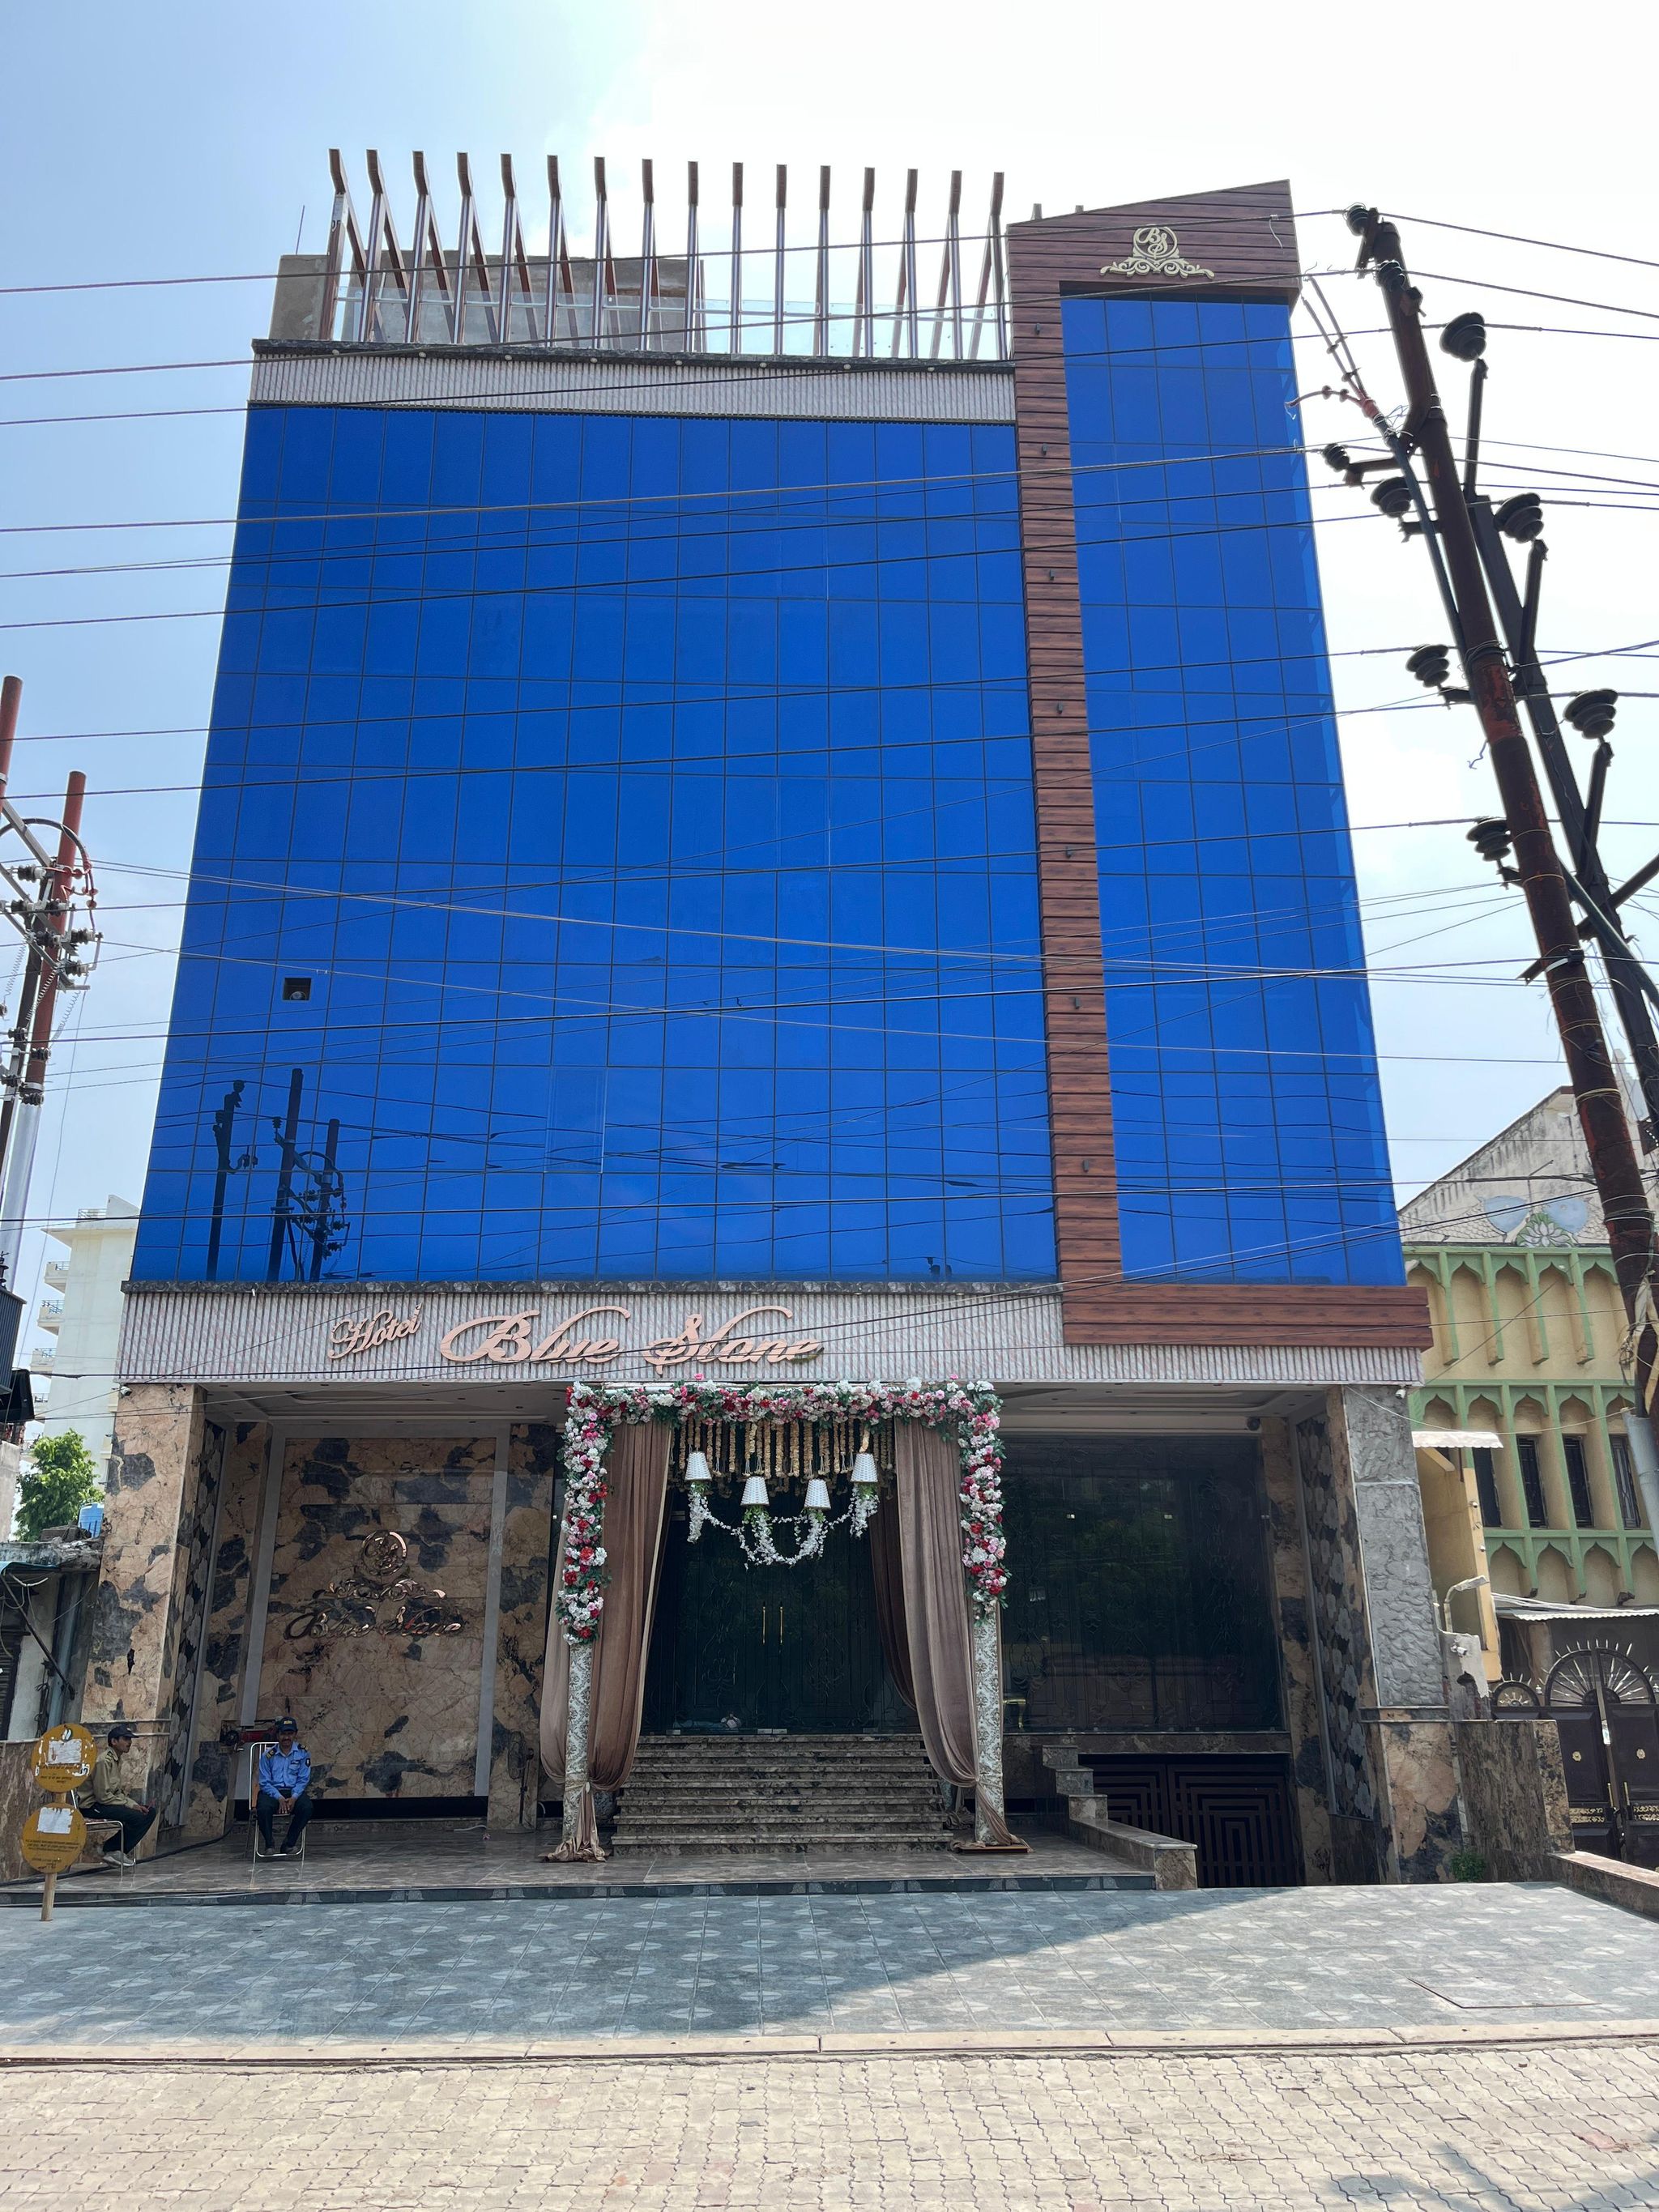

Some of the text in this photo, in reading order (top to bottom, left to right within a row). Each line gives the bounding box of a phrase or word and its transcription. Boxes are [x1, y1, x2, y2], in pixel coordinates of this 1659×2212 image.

[327, 1302, 825, 1375] Hotel Blue Stone
